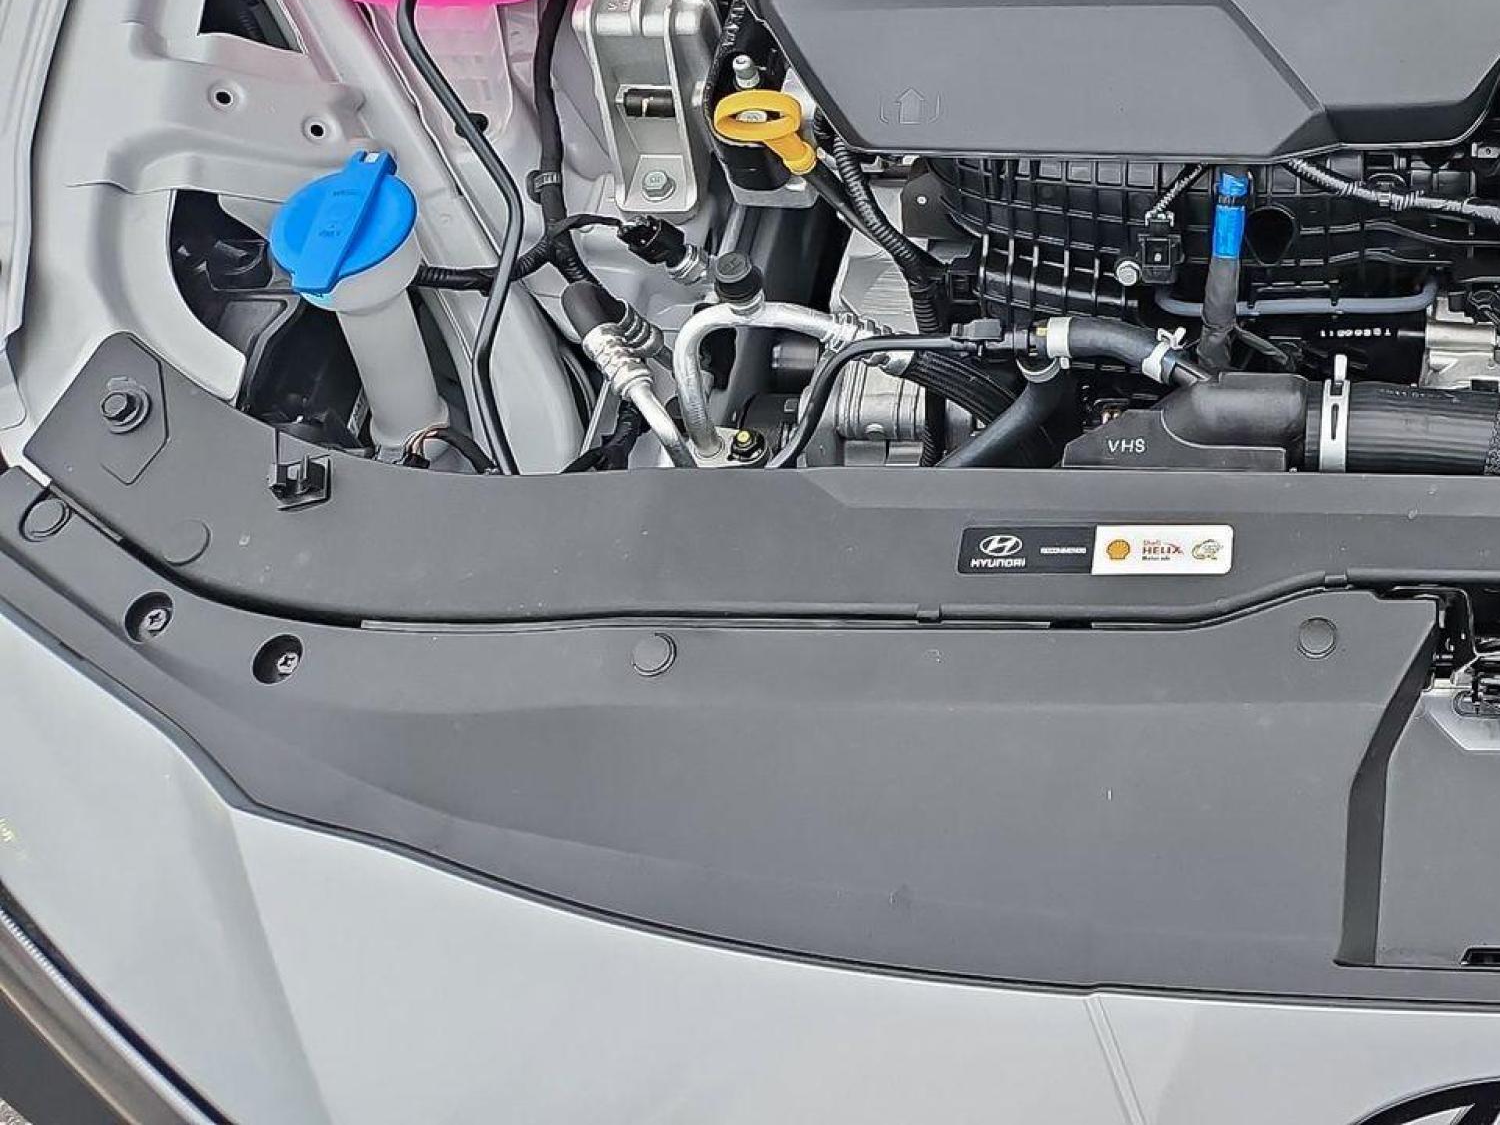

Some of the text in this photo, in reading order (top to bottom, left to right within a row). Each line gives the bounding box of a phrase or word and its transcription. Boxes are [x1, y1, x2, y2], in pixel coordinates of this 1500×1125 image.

[1107, 438, 1146, 453] VHS
[1142, 545, 1184, 554] HELIX
[970, 558, 1026, 568] HYUNDAI
